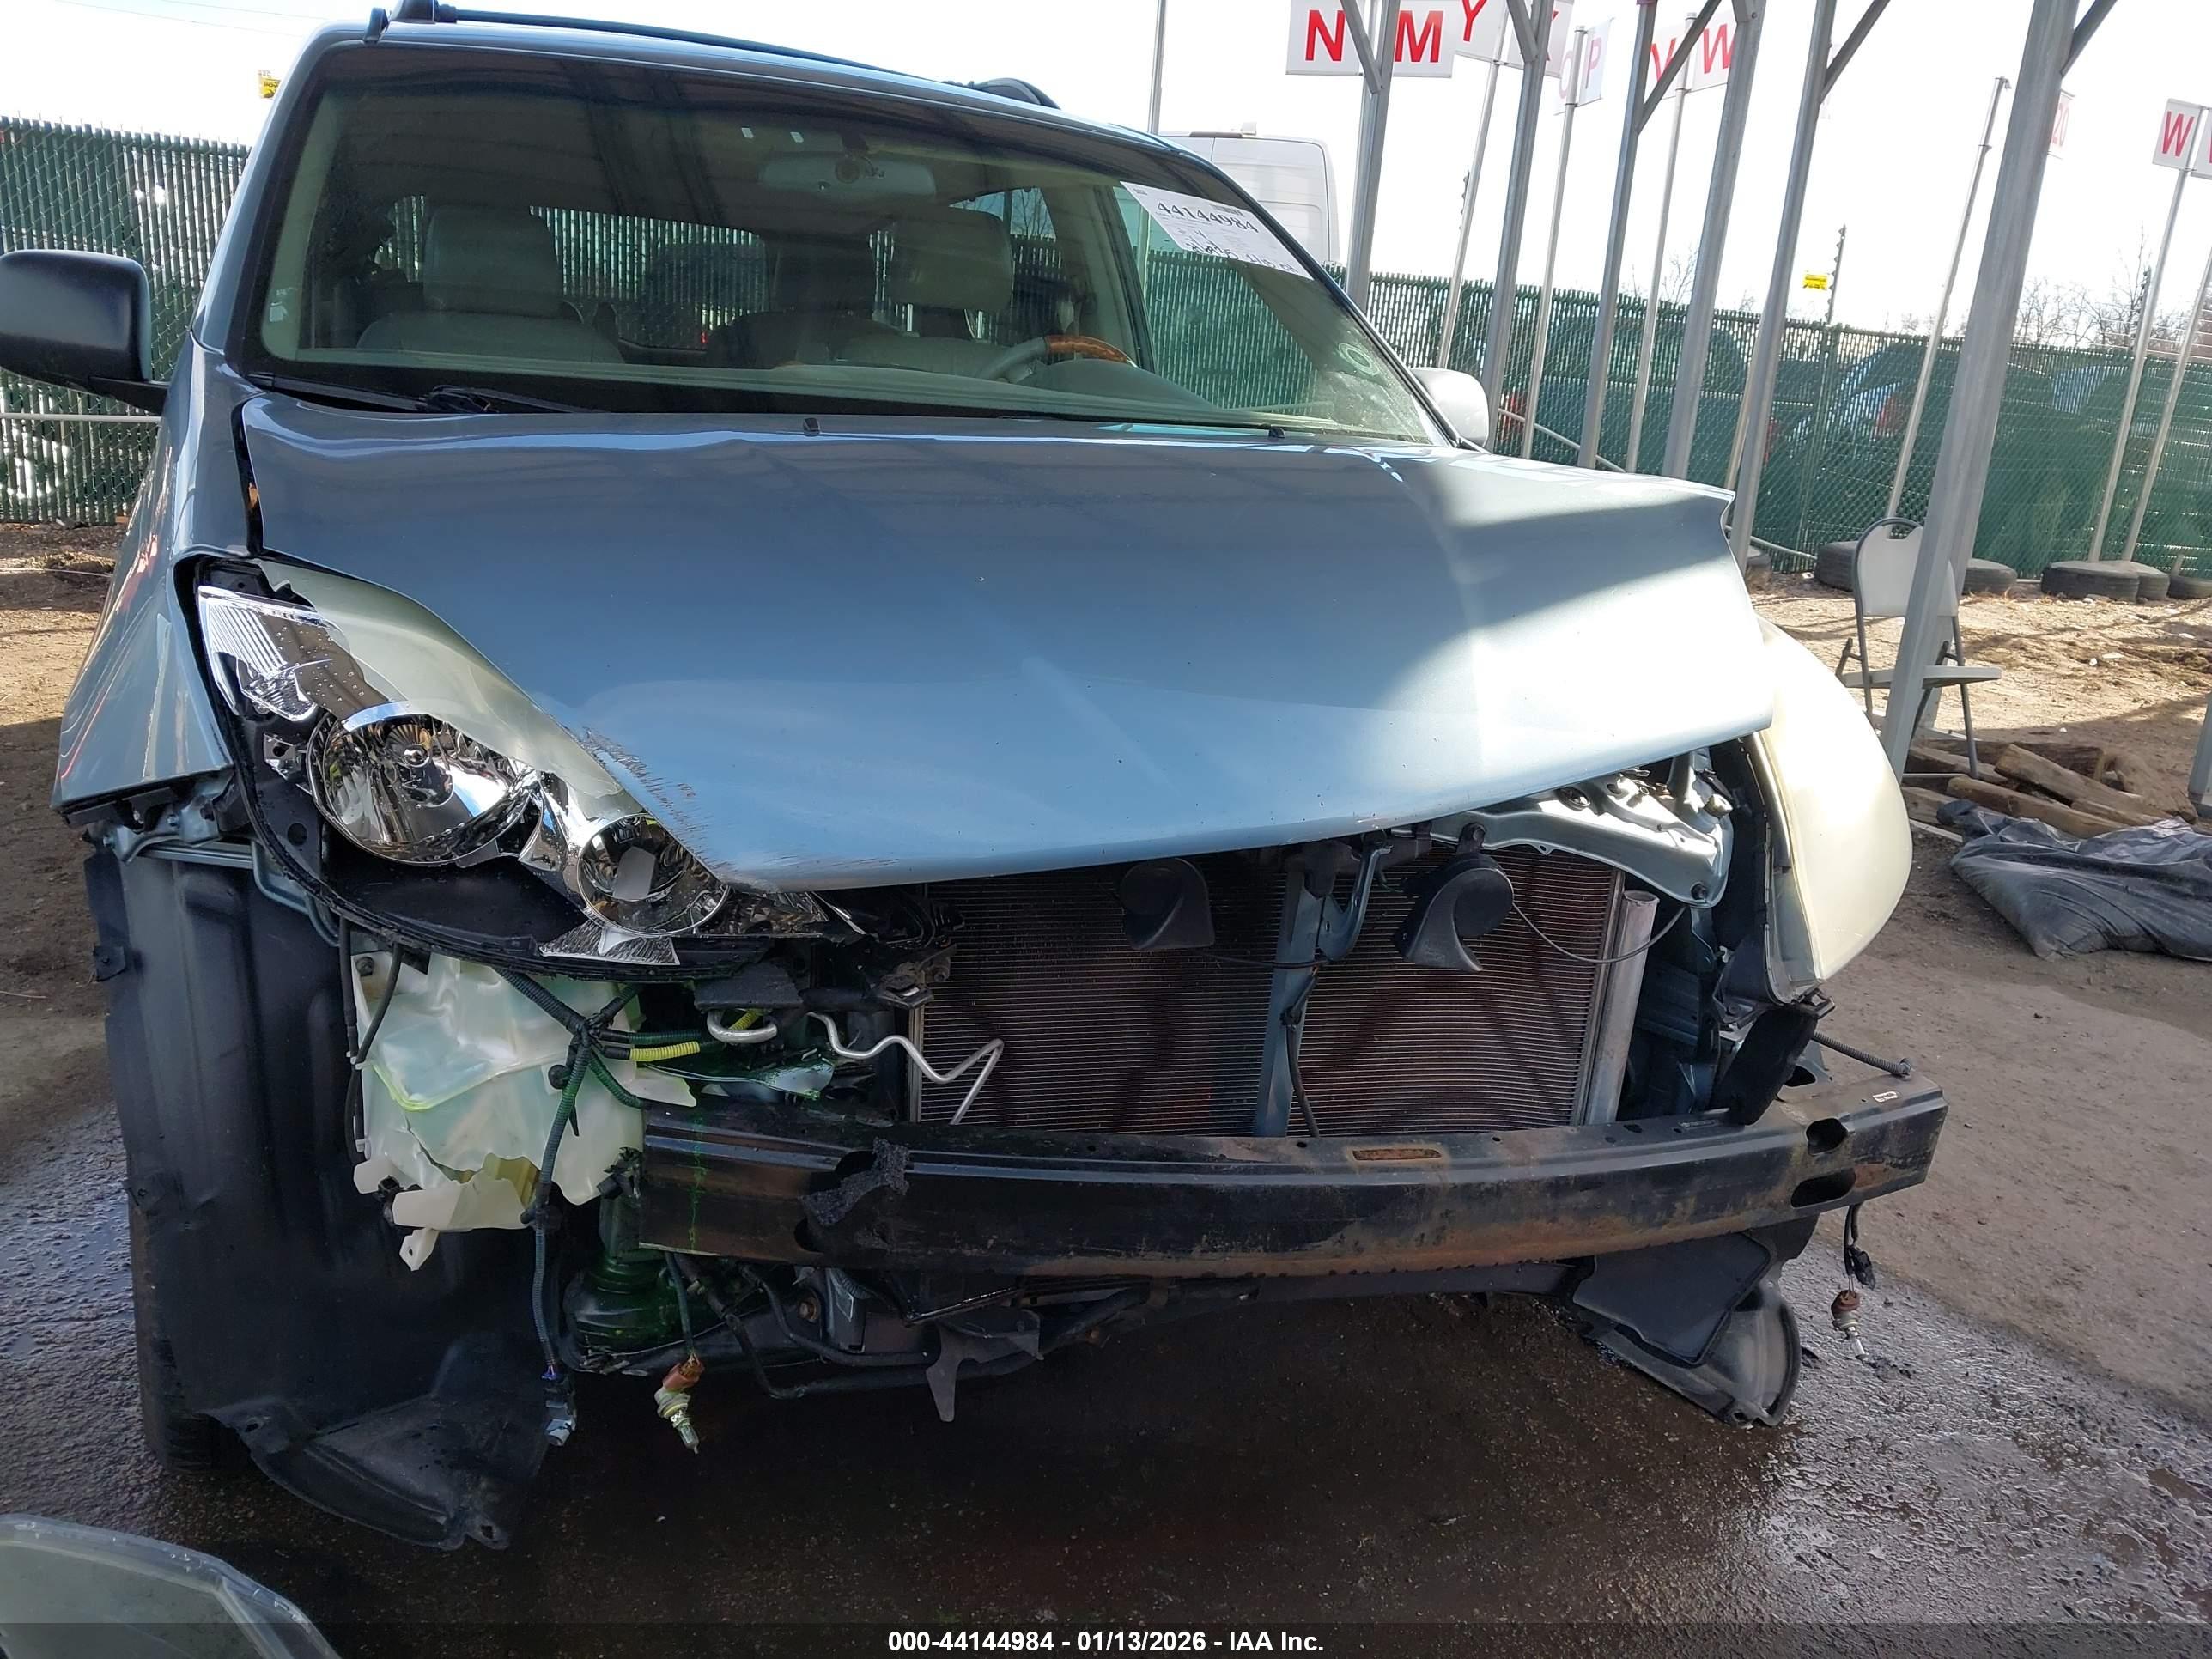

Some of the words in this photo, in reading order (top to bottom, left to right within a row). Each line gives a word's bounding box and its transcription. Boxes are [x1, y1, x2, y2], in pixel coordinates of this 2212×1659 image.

[1305, 10, 1346, 61] N
[1395, 10, 1443, 63] M
[1462, 0, 1487, 41] Y
[2162, 111, 2195, 157] W
[1158, 201, 1259, 234] 44144984
